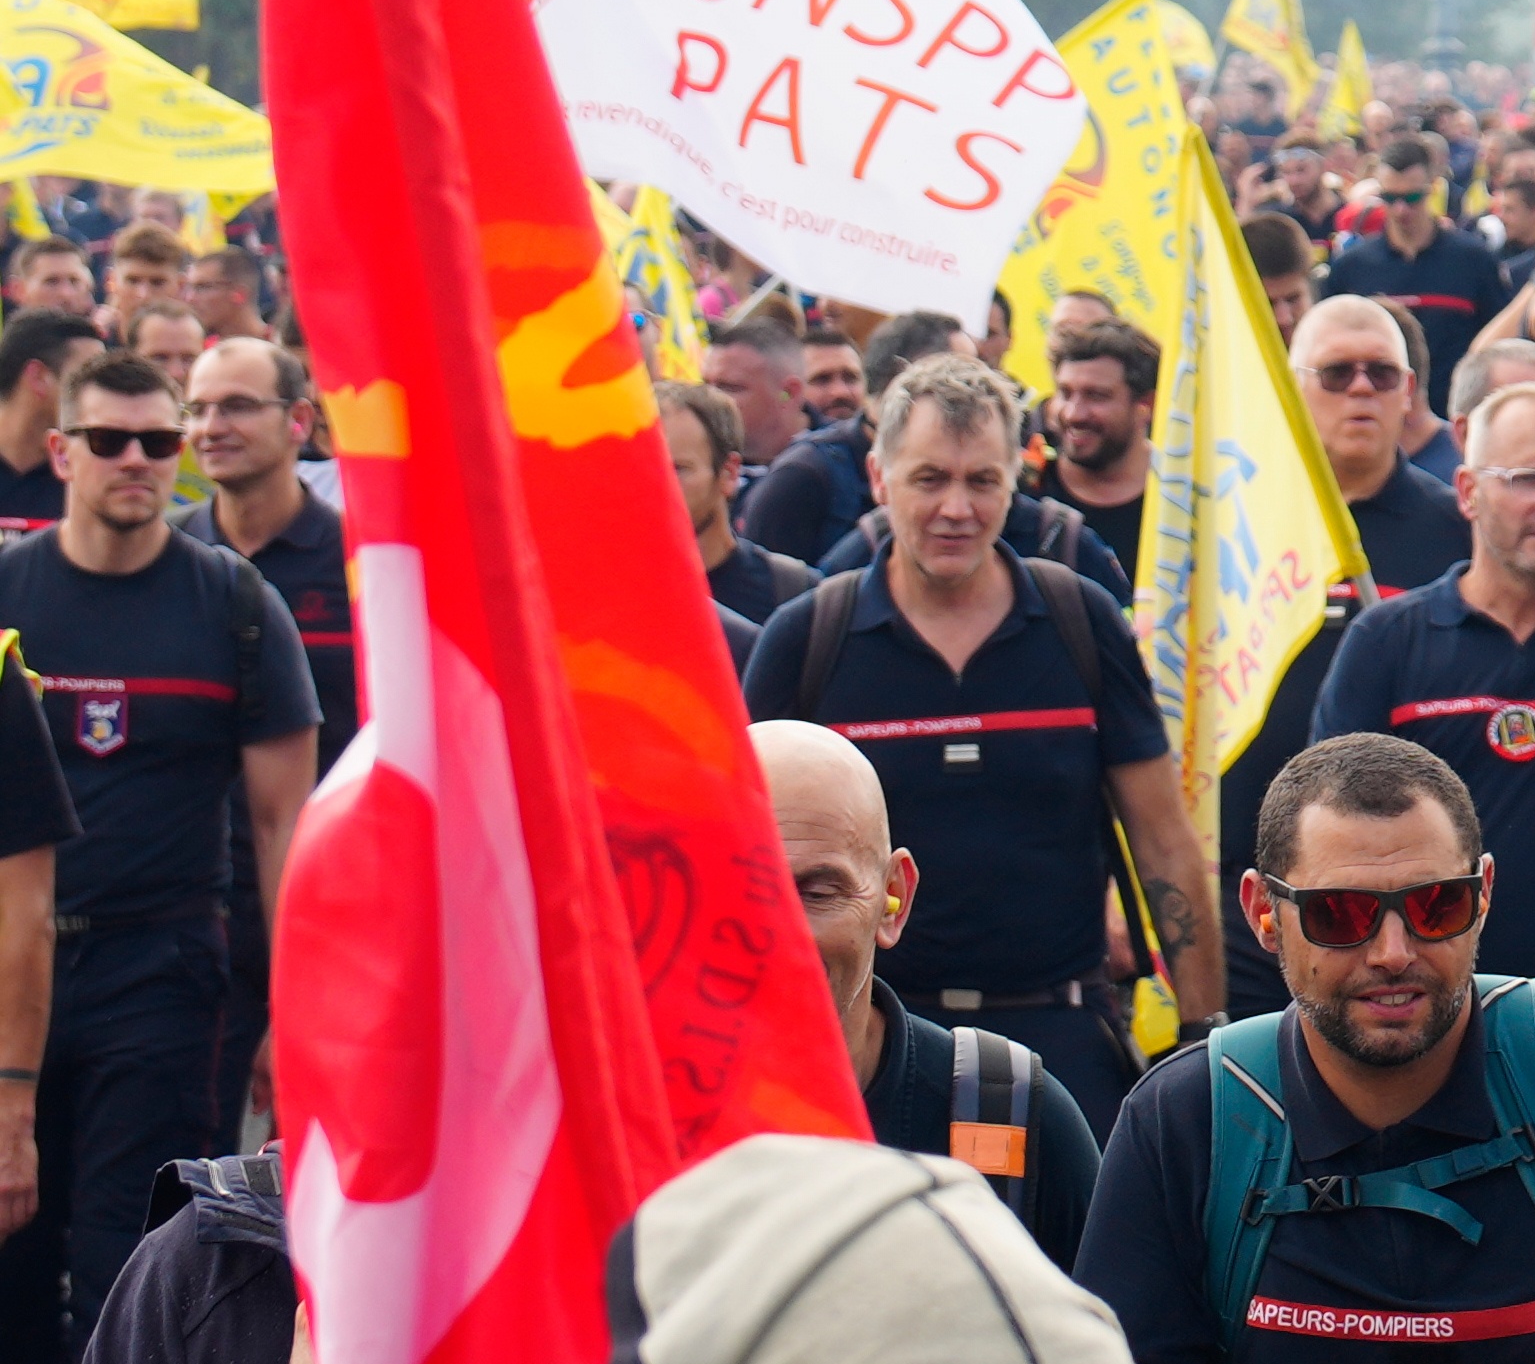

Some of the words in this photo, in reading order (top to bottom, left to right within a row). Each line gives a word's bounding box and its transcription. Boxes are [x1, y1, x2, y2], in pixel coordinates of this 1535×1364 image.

[576, 95, 717, 188] revendique,
[719, 178, 779, 223] c'est
[783, 200, 836, 235] pour
[838, 219, 962, 277] construire.
[670, 29, 1025, 212] PATS
[1248, 1298, 1455, 1338] SAPEURS-POMPIERS
